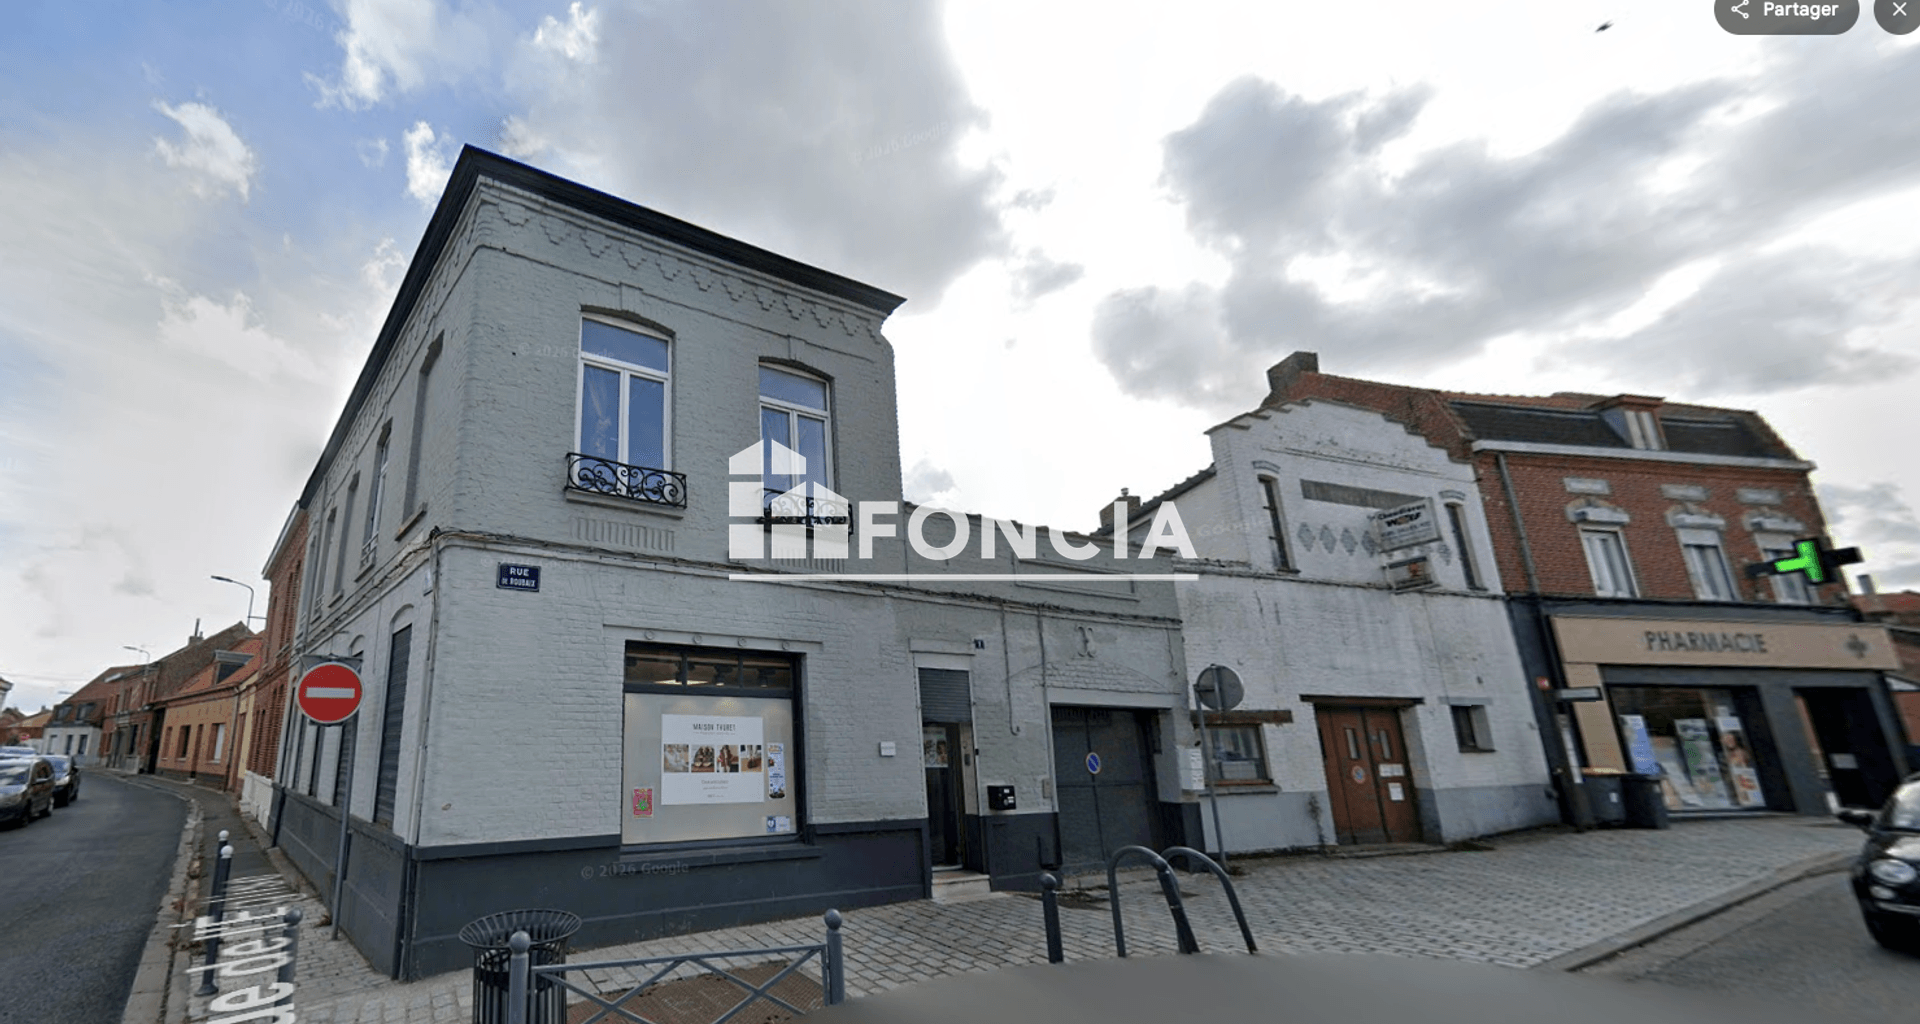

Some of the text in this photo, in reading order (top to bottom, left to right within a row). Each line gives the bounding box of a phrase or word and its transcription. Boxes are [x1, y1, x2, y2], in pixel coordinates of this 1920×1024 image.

[509, 566, 530, 577] RUE
[1643, 631, 1768, 653] PHARMACIE
[692, 723, 714, 731] MAISON
